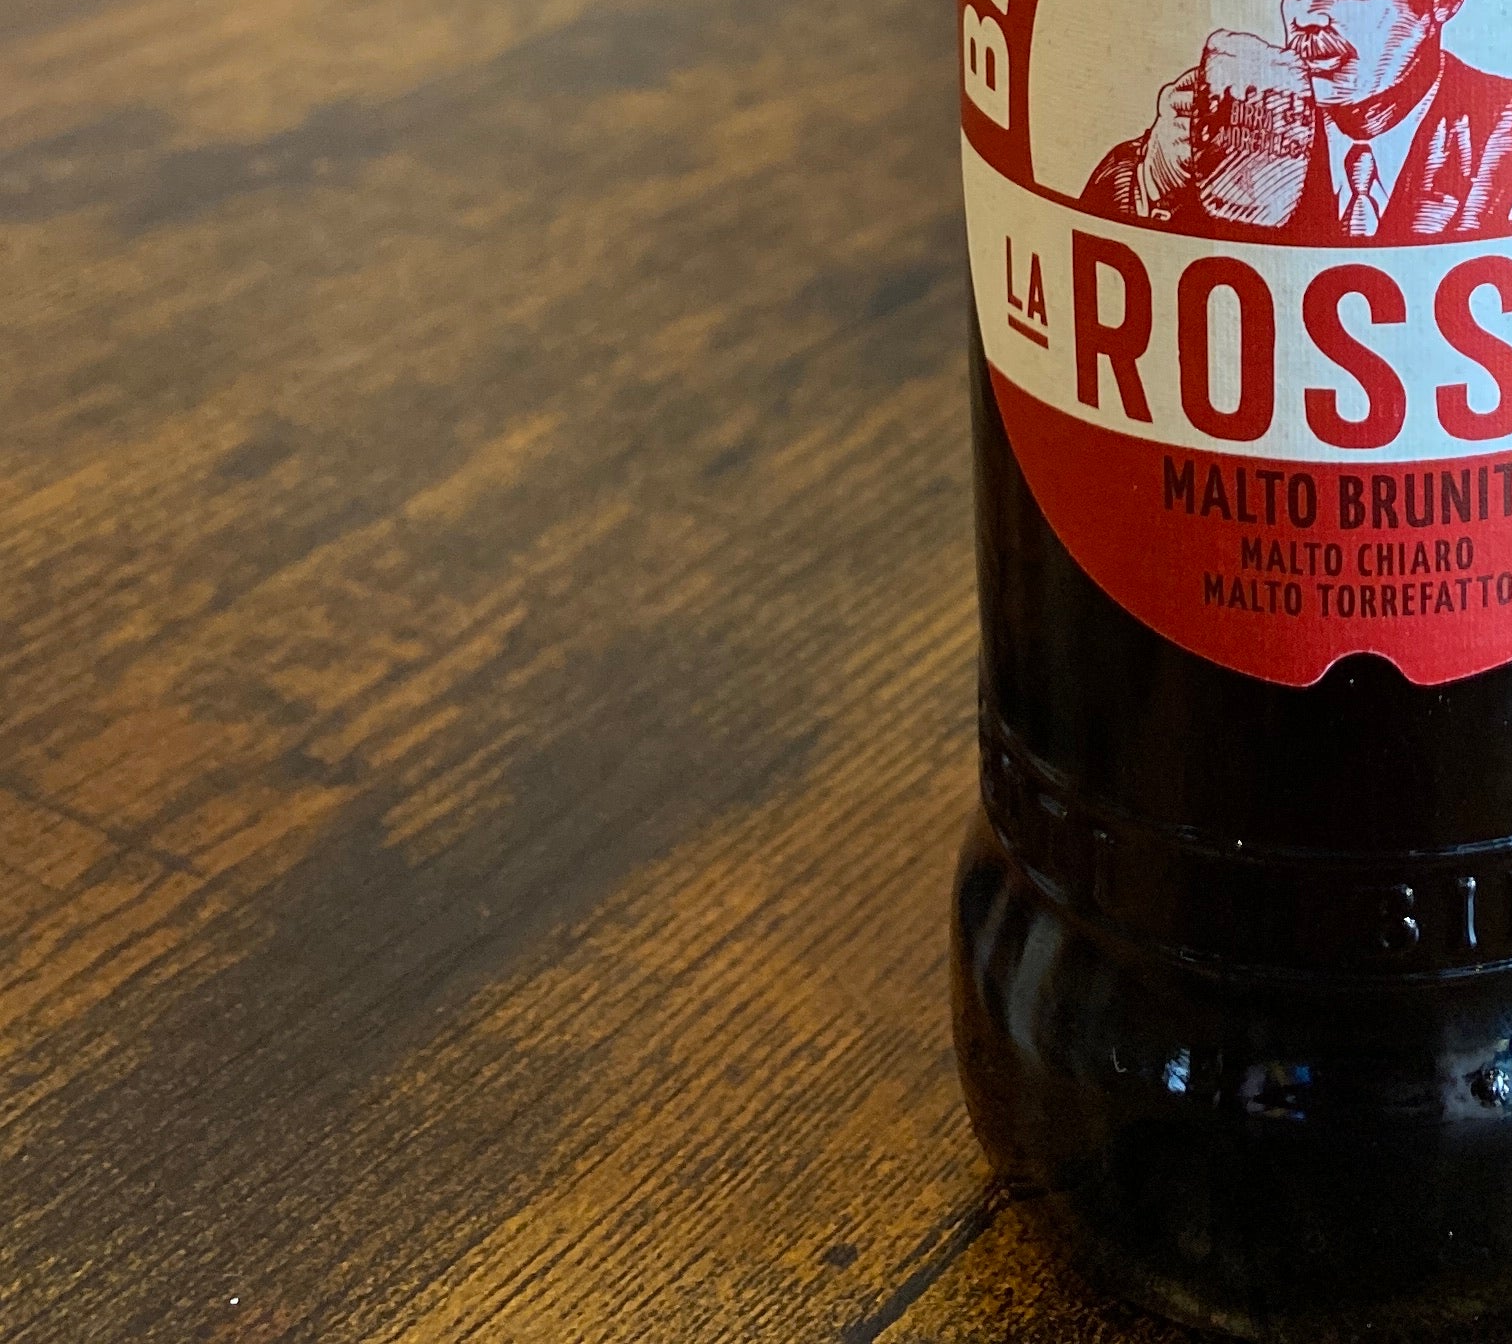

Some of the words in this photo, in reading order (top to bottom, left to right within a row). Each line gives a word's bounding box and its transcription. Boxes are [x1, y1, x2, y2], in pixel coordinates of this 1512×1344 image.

[1005, 234, 1050, 327] LA
[1162, 454, 1318, 529] MALTO
[1240, 536, 1343, 577] MALTO
[1357, 535, 1475, 577] CHIARO
[1203, 571, 1304, 618] MALTO
